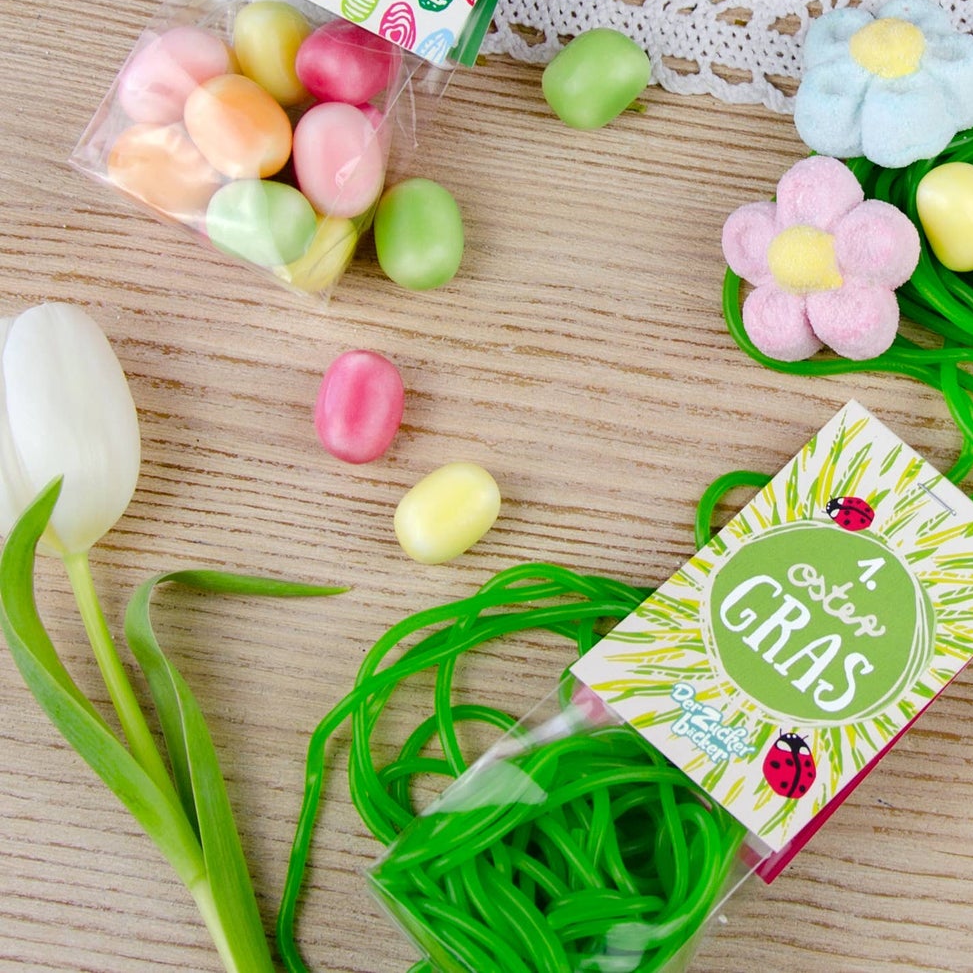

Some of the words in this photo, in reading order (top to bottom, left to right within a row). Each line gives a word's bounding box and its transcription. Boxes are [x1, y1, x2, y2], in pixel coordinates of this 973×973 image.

[787, 563, 886, 637] Oster
[857, 557, 886, 592] 1.
[720, 574, 875, 713] GRAS
[670, 682, 703, 713] Der
